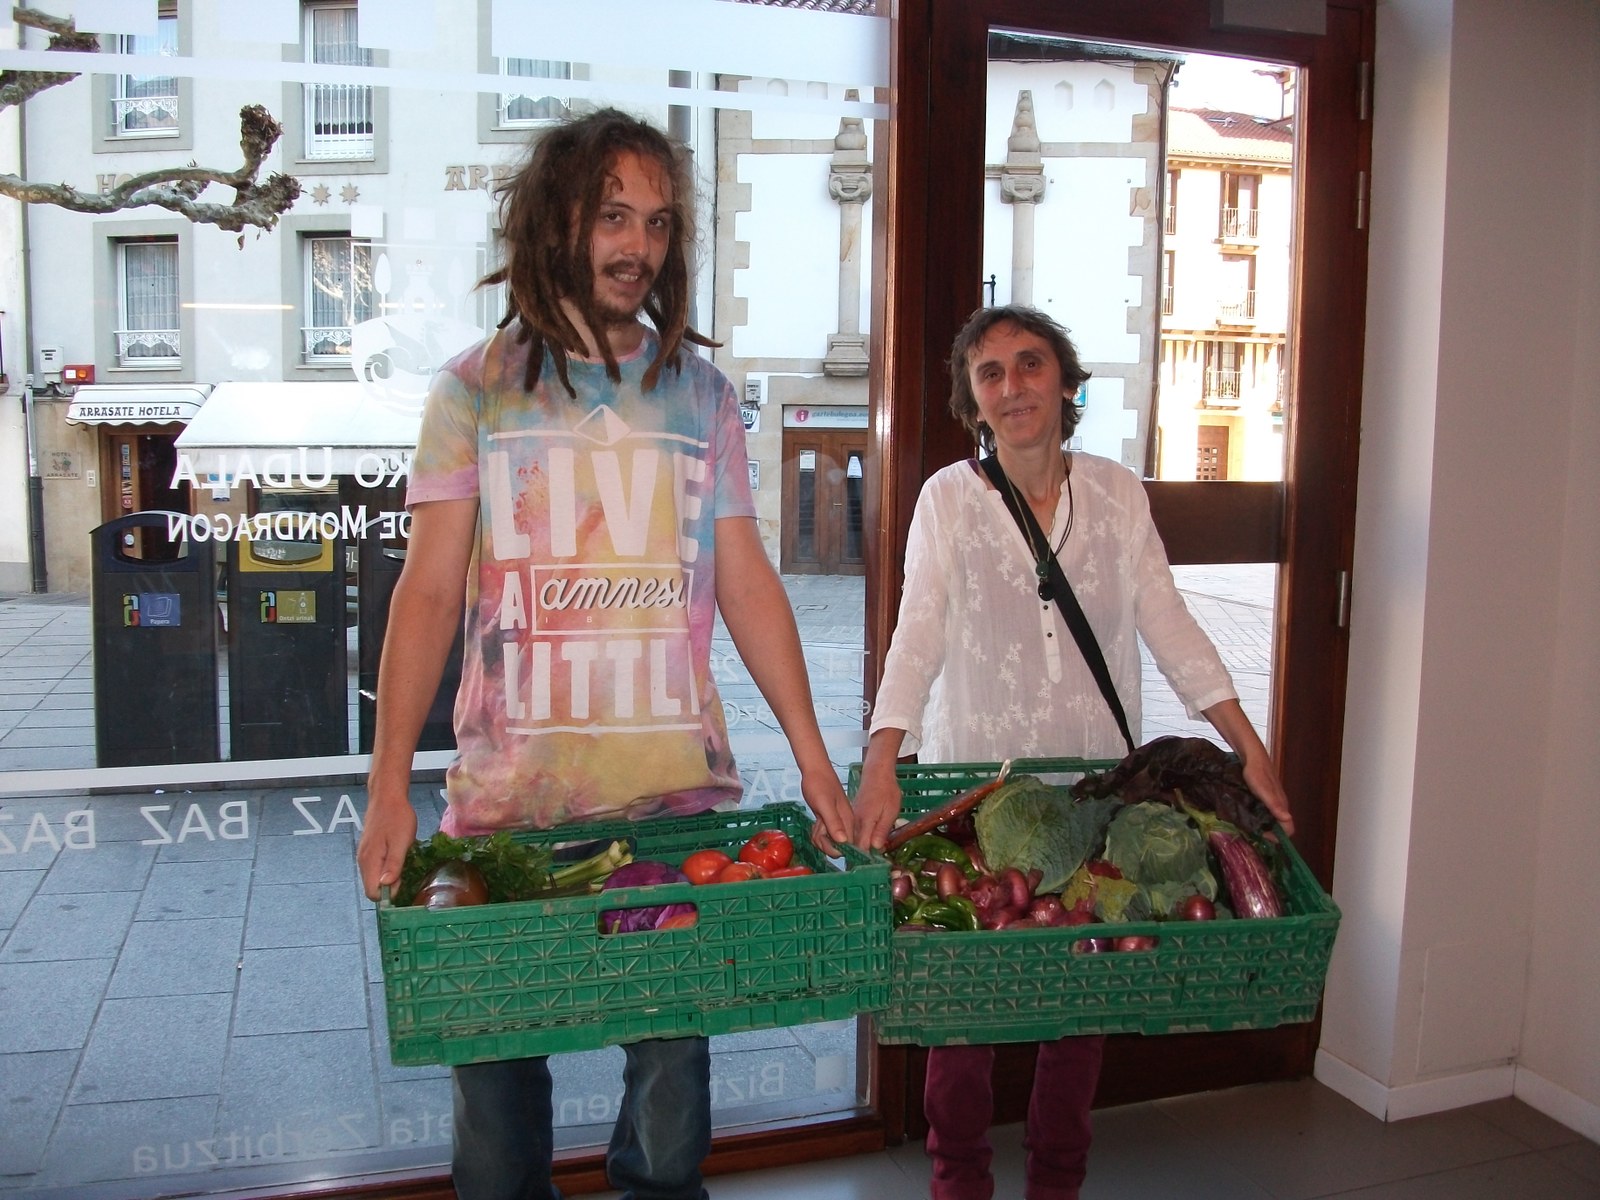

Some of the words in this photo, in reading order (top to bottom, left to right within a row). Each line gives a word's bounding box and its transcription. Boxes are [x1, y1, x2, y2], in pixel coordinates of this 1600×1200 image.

[79, 406, 134, 417] ARRASATE
[138, 406, 181, 416] HOTELA
[488, 447, 706, 563] LIVE
[500, 570, 527, 631] A
